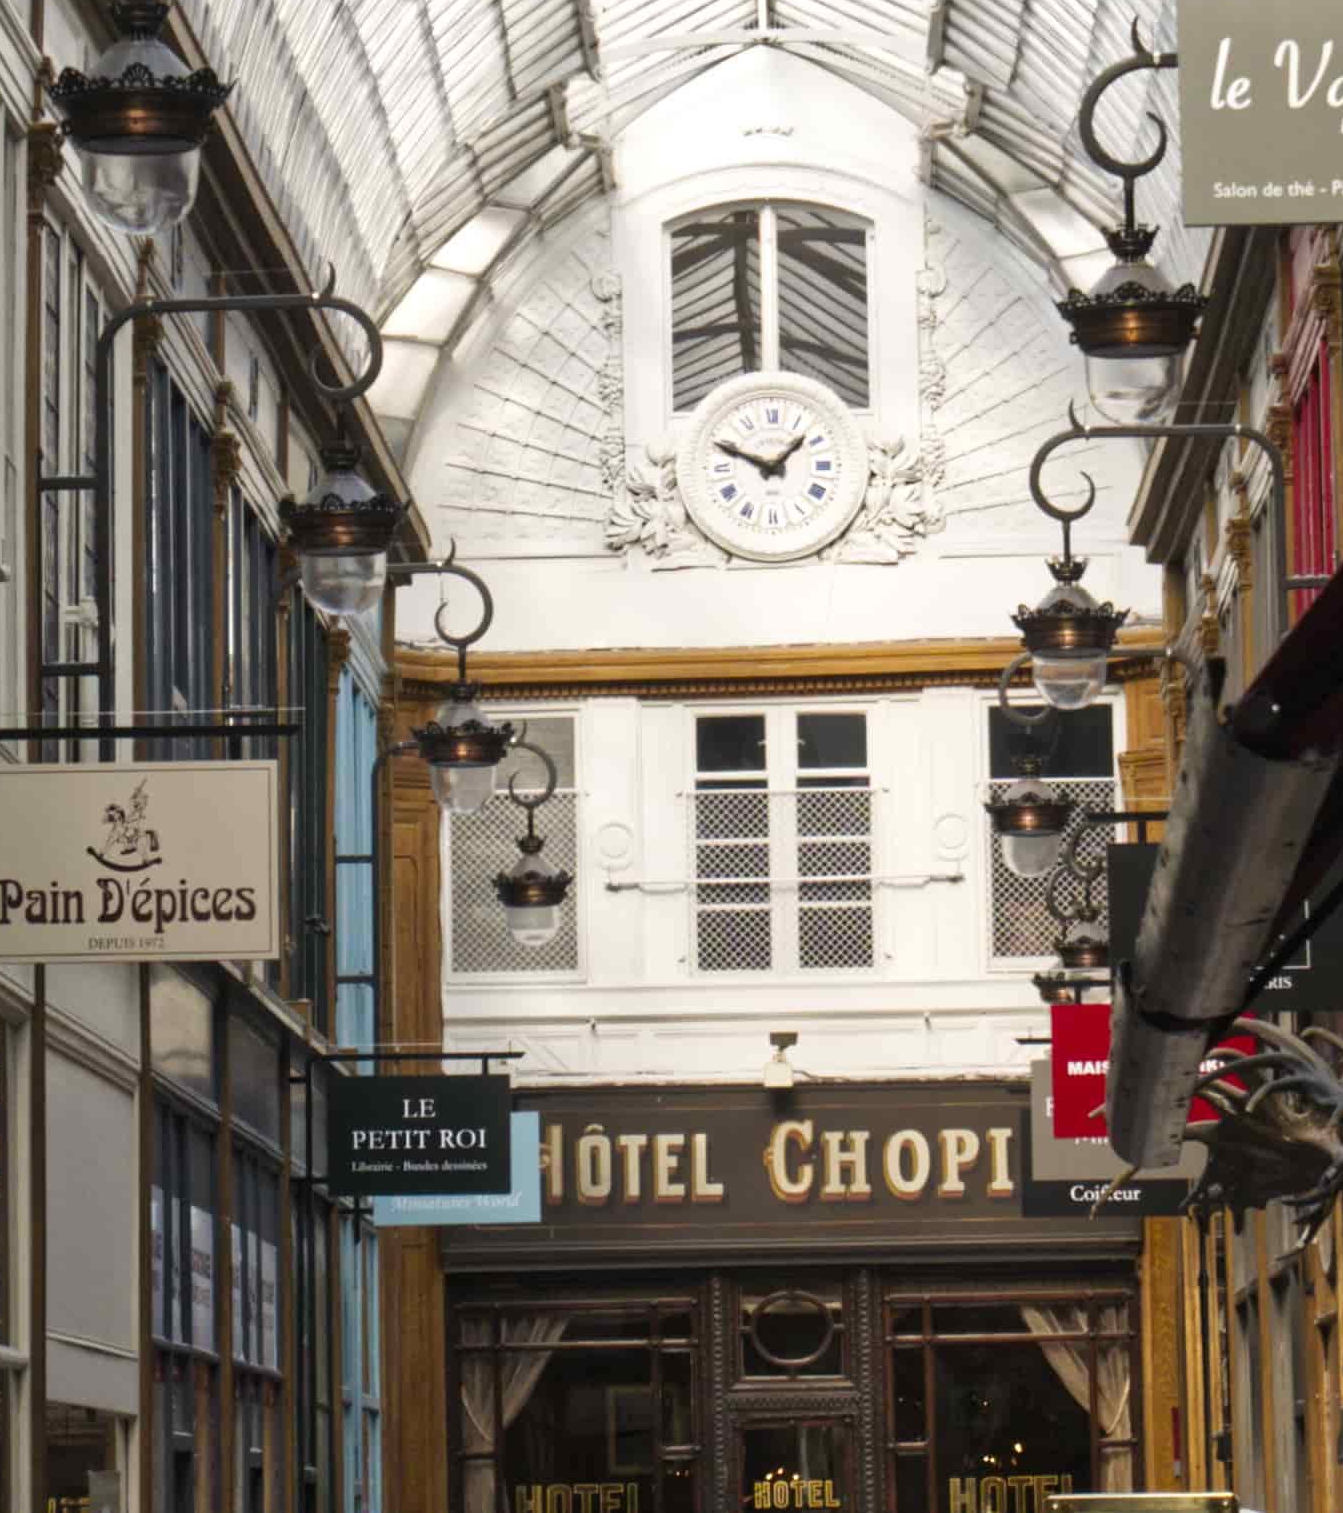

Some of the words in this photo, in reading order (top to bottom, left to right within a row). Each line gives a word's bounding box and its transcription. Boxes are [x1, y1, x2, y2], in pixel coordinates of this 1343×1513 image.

[1211, 37, 1252, 110] le
[1213, 182, 1258, 198] Salon
[1261, 180, 1283, 197] de
[1288, 180, 1315, 197] thé
[96, 877, 257, 934] D'épices
[88, 937, 136, 950] DEPUIS
[1067, 1060, 1110, 1076] MAIS
[401, 1098, 436, 1118] LE
[351, 1129, 431, 1150] PETIT
[439, 1128, 487, 1149] ROI
[403, 1159, 439, 1171] Bandes
[763, 1119, 1015, 1203] CHOPI
[1069, 1185, 1141, 1202] Coifeur
[753, 1479, 840, 1509] HOTEL
